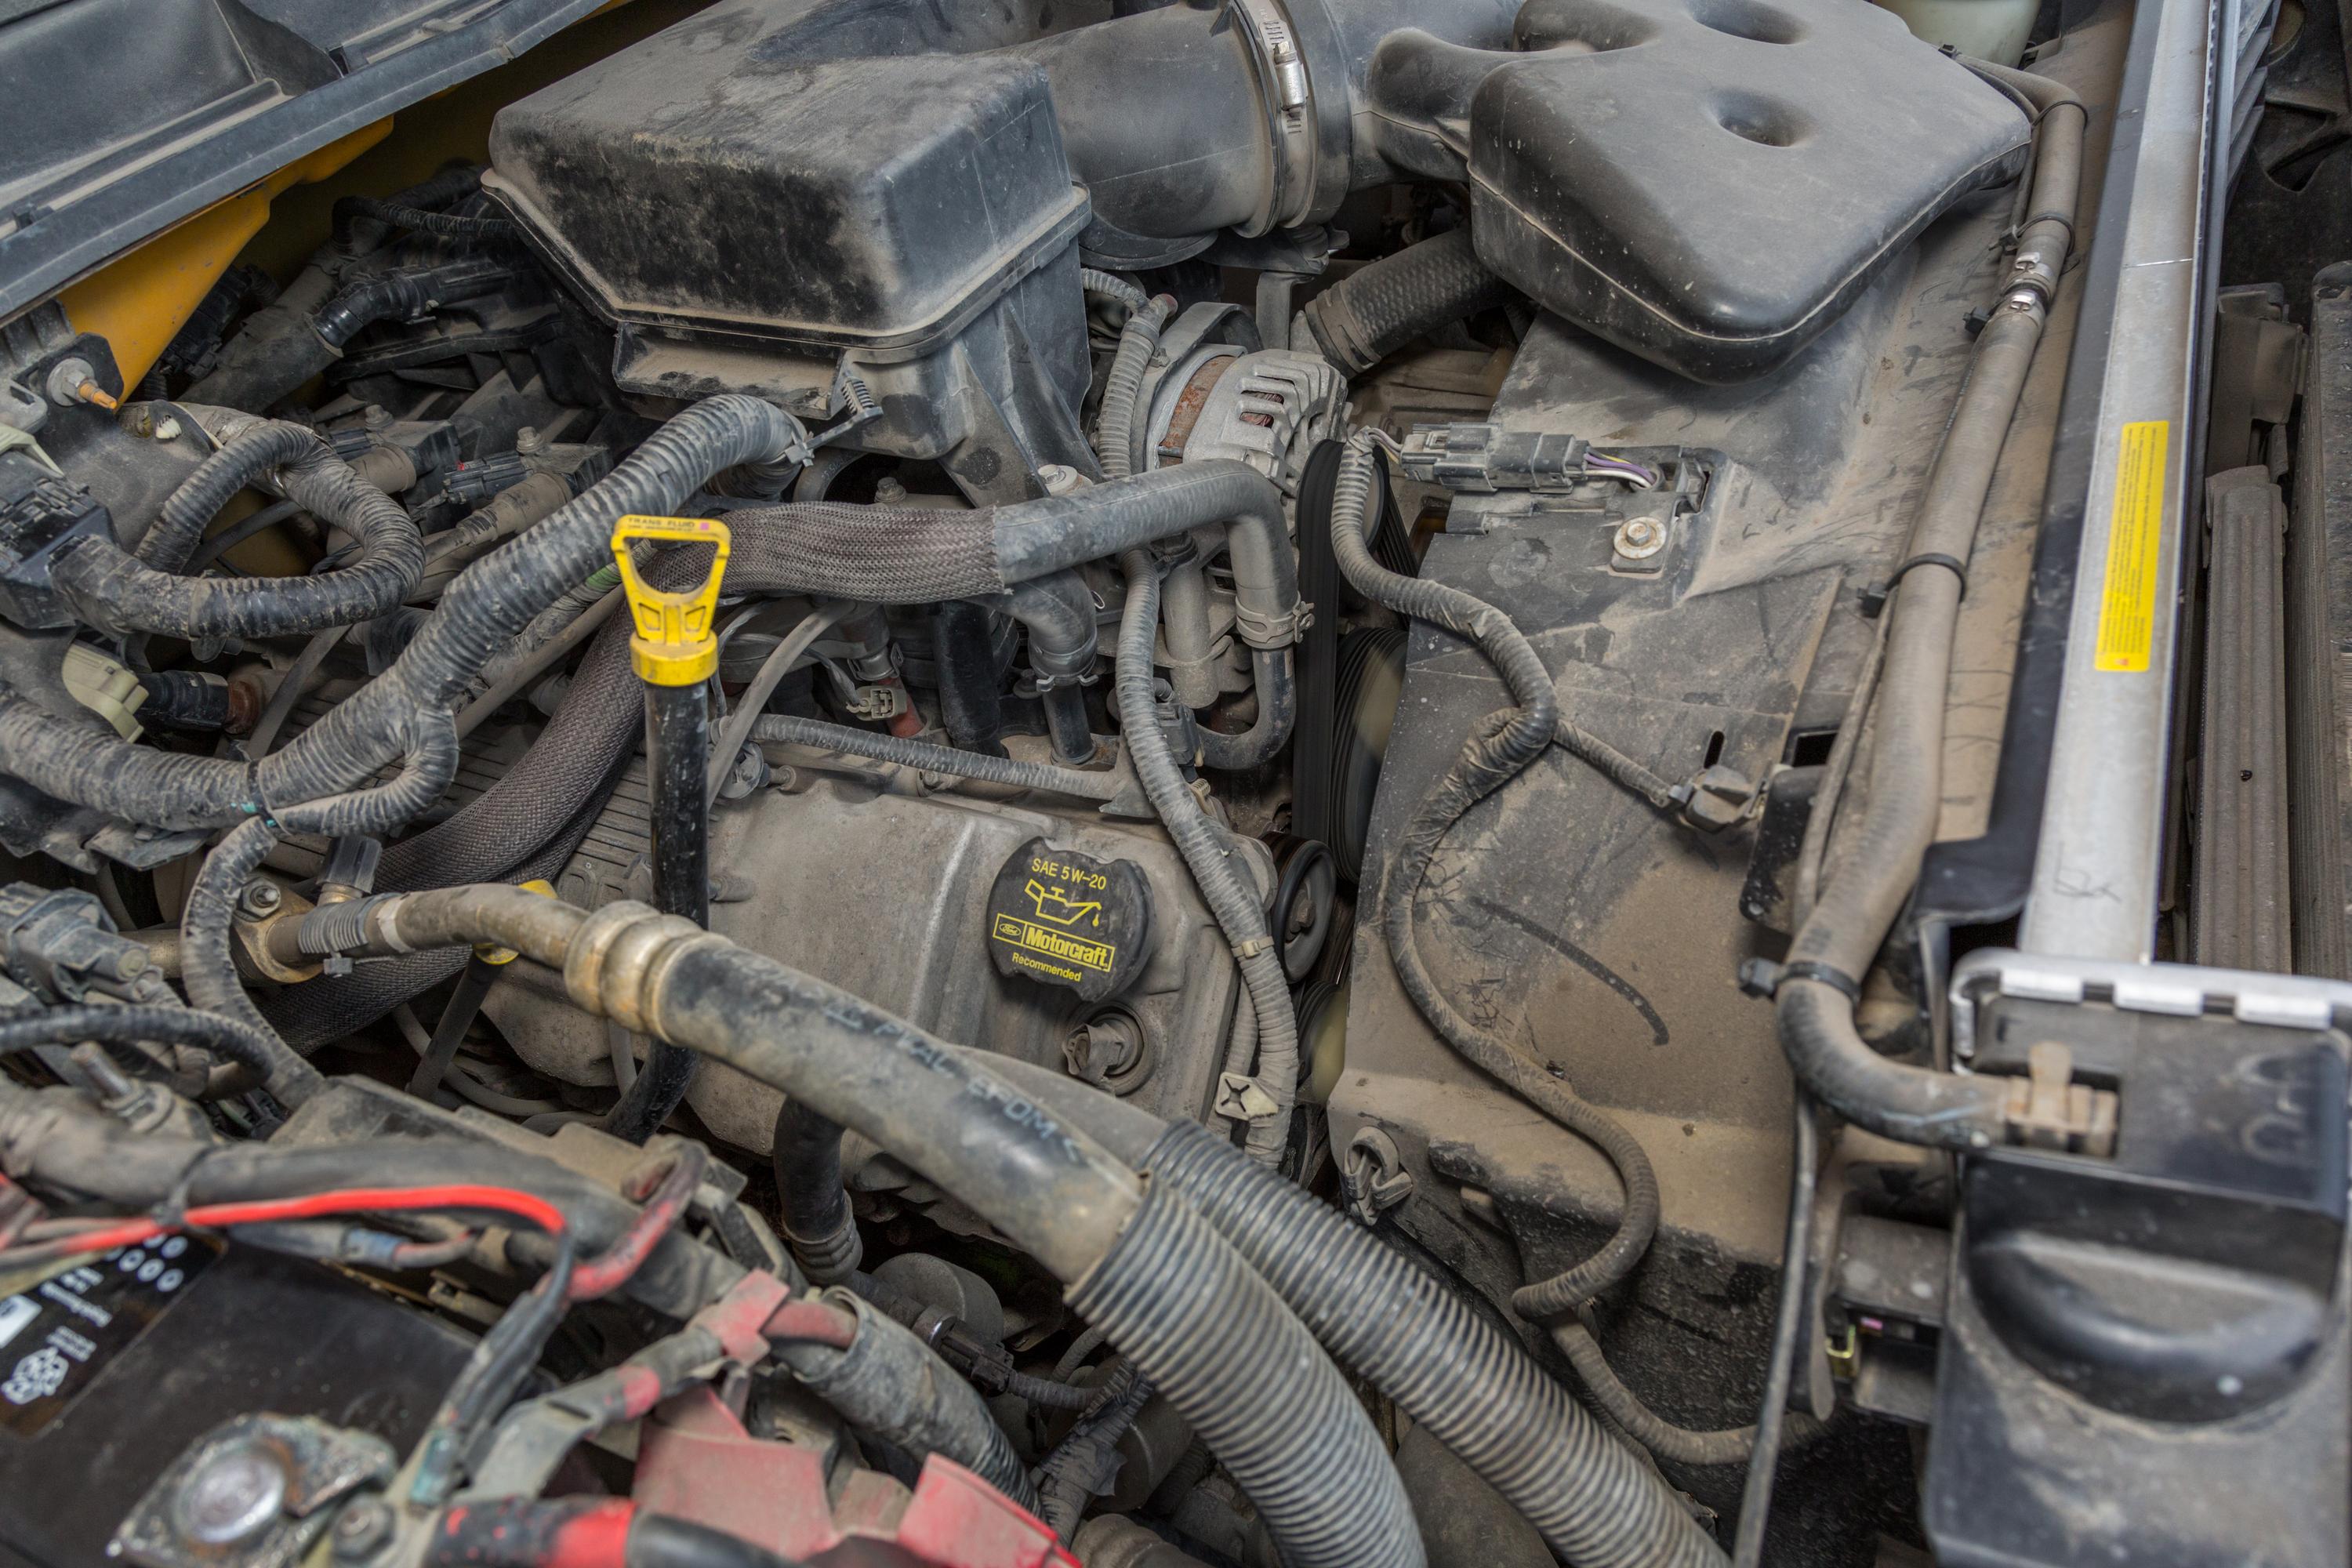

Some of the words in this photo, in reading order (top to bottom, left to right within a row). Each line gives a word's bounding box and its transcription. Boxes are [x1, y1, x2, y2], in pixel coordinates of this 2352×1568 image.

[1031, 858, 1058, 877] SAE
[1061, 866, 1107, 891] 5W-20
[1025, 926, 1108, 967] Motorcraft
[1011, 952, 1082, 982] Recommended
